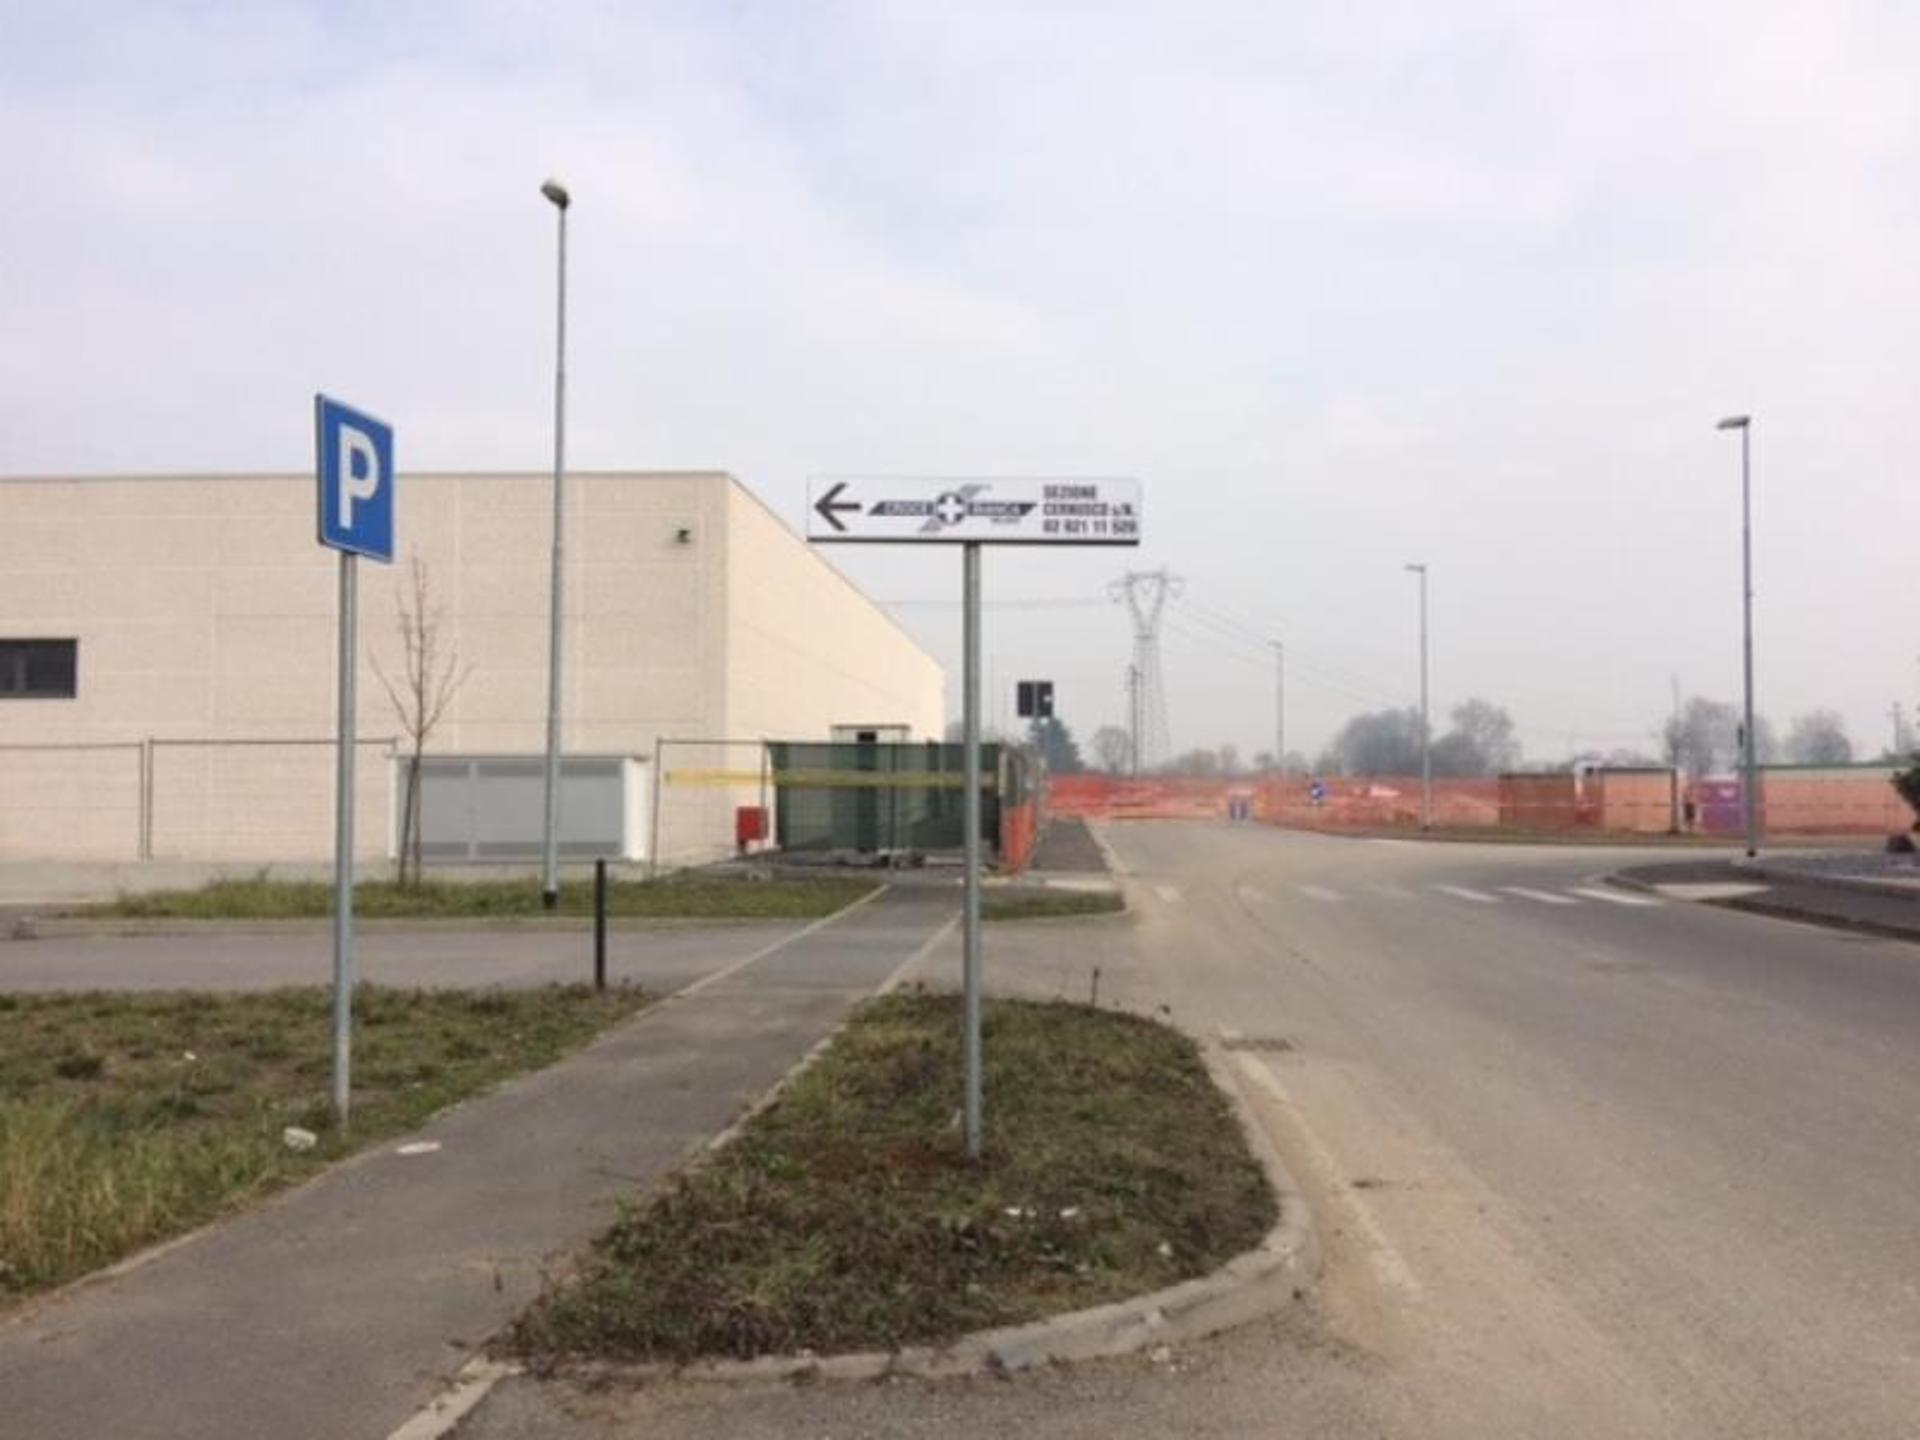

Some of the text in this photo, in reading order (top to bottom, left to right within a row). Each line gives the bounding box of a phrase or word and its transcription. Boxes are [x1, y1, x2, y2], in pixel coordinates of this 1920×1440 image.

[338, 422, 379, 529] P
[1043, 485, 1096, 499] SEZIONE
[1043, 520, 1059, 533] 02
